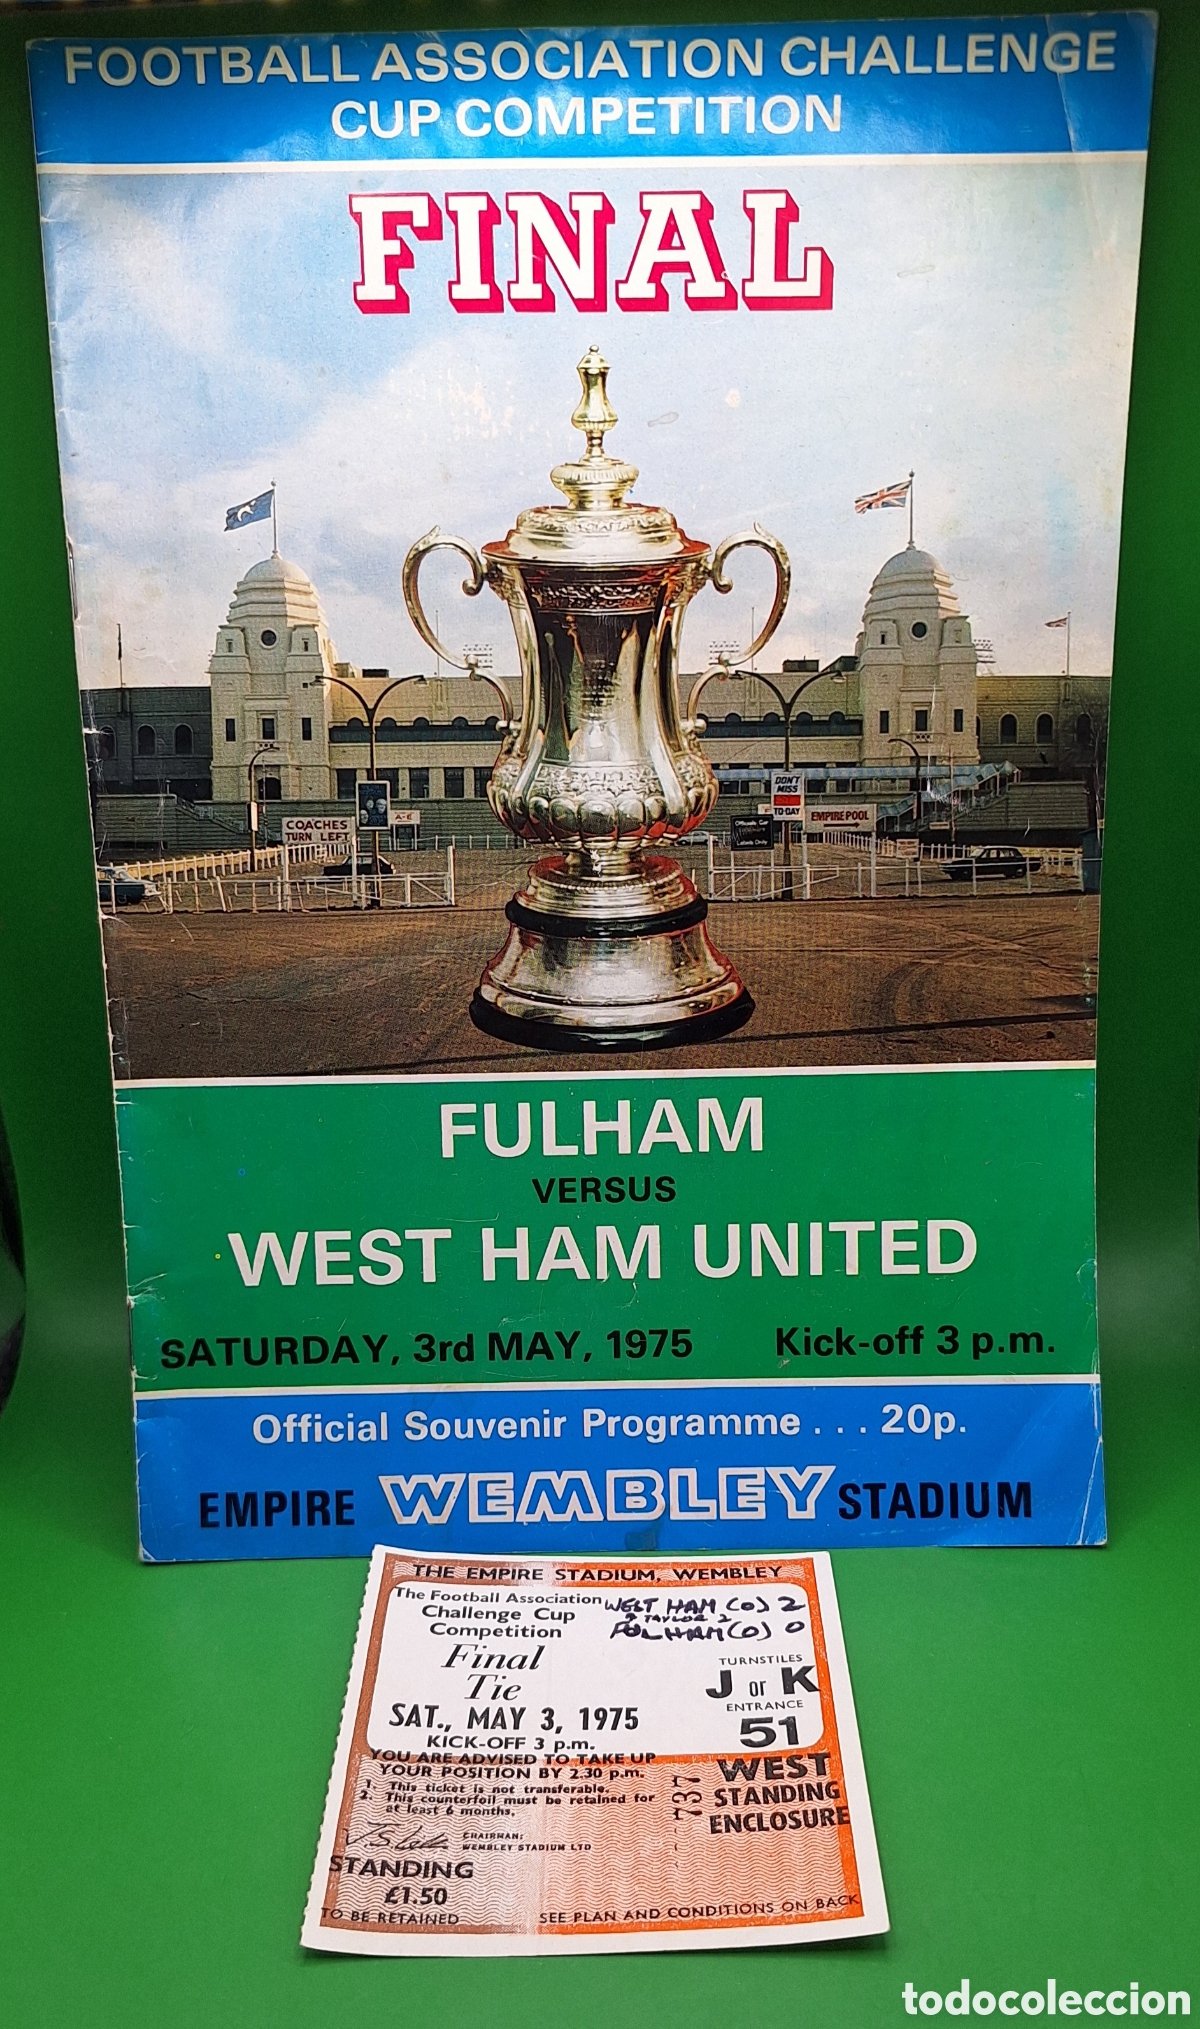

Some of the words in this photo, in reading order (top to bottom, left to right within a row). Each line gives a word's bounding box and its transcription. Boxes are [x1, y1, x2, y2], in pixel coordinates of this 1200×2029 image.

[64, 44, 361, 86] FOOTBALL
[371, 37, 764, 83] ASSOCIATION
[779, 30, 1118, 75] CHALLENGE
[331, 98, 440, 140] CUP
[456, 93, 842, 137] COMPETITION
[349, 190, 834, 315] FINAL
[776, 785, 798, 793] MISS
[286, 820, 348, 830] COACHES
[811, 811, 844, 821] EMPIRE
[845, 810, 869, 821] POOL
[285, 832, 312, 841] TURN
[320, 832, 350, 841] LEFT
[440, 1097, 764, 1159] FULHAM
[532, 1175, 677, 1203] VERSUS
[227, 1228, 452, 1287] WEST
[482, 1224, 661, 1282] HAM
[693, 1219, 978, 1279] UNITED
[160, 1334, 401, 1370] SATURDAY,
[413, 1333, 475, 1363] 3rd
[488, 1330, 593, 1364] MAY,
[606, 1328, 693, 1360] 1975
[775, 1325, 924, 1357] Kick-off
[936, 1324, 960, 1356] 3
[971, 1330, 1056, 1360] p.m.
[252, 1412, 389, 1445] Official
[403, 1408, 566, 1441] Souvenir
[582, 1409, 802, 1444] Programme
[880, 1403, 967, 1440] 20p.
[200, 1489, 355, 1528] EMPIRE
[378, 1465, 837, 1525] WEMBLEY
[837, 1482, 1033, 1520] STADIUM
[413, 1564, 455, 1579] THE
[466, 1567, 544, 1581] EMPIRE
[555, 1568, 662, 1582] STADIUM,
[673, 1566, 782, 1581] WEMBLEY
[396, 1587, 426, 1600] The
[431, 1590, 500, 1603] Football
[506, 1593, 602, 1605] Association
[667, 1599, 716, 1614] HAM
[778, 1597, 806, 1612] 2
[421, 1605, 522, 1624] Challenge
[533, 1608, 576, 1624] Cup
[429, 1622, 563, 1640] Competition
[441, 1643, 546, 1670] Final
[719, 1654, 803, 1666] TURNSTILES
[464, 1674, 522, 1701] Tie
[705, 1669, 733, 1698] J
[749, 1680, 766, 1697] or
[781, 1665, 820, 1694] K
[726, 1700, 804, 1712] ENTRANCE
[389, 1703, 452, 1732] SAT.,
[467, 1707, 526, 1730] MAY
[540, 1708, 563, 1734] 3,
[579, 1707, 639, 1731] 1975
[740, 1715, 800, 1748] 51
[427, 1735, 526, 1750] KICK-OFF
[533, 1737, 545, 1750] 3
[554, 1740, 596, 1753] p.m.
[370, 1749, 410, 1762] YOU
[417, 1752, 453, 1764] ARE
[459, 1753, 537, 1765] ADVISED
[544, 1754, 570, 1765] TO
[577, 1753, 624, 1765] TAKE
[630, 1752, 656, 1764] UP
[717, 1753, 830, 1782] WEST
[380, 1763, 432, 1777] YOUR
[441, 1766, 531, 1779] POSITION
[539, 1768, 562, 1779] BY
[570, 1768, 602, 1780] 2.30
[609, 1769, 645, 1781] p.m.
[360, 1790, 373, 1800] 2.
[386, 1792, 413, 1802] This
[420, 1794, 496, 1805] counterfoil
[504, 1796, 537, 1805] must
[545, 1795, 561, 1805] be
[570, 1794, 626, 1805] retained
[634, 1794, 655, 1803] for
[365, 1779, 376, 1789] 1.
[388, 1781, 417, 1792] This
[426, 1783, 465, 1793] ticket
[474, 1784, 484, 1793] is
[492, 1784, 515, 1794] not
[524, 1784, 609, 1794] transferable.
[672, 1774, 702, 1820] 737
[714, 1782, 840, 1807] STANDING
[385, 1805, 399, 1813] at
[407, 1805, 439, 1815] least
[445, 1805, 454, 1815] 6
[710, 1807, 850, 1834] ENCLOSURE
[329, 1856, 474, 1879] STANDING
[384, 1886, 448, 1905] £1.50
[321, 1907, 344, 1920] TO
[351, 1912, 370, 1922] BE
[378, 1913, 459, 1925] RETAINED
[539, 1913, 566, 1924] SEE
[573, 1911, 616, 1923] PLAN
[623, 1908, 660, 1920] AND
[667, 1903, 774, 1919] CONDITIONS
[782, 1901, 807, 1913] ON
[816, 1894, 859, 1909] BACK
